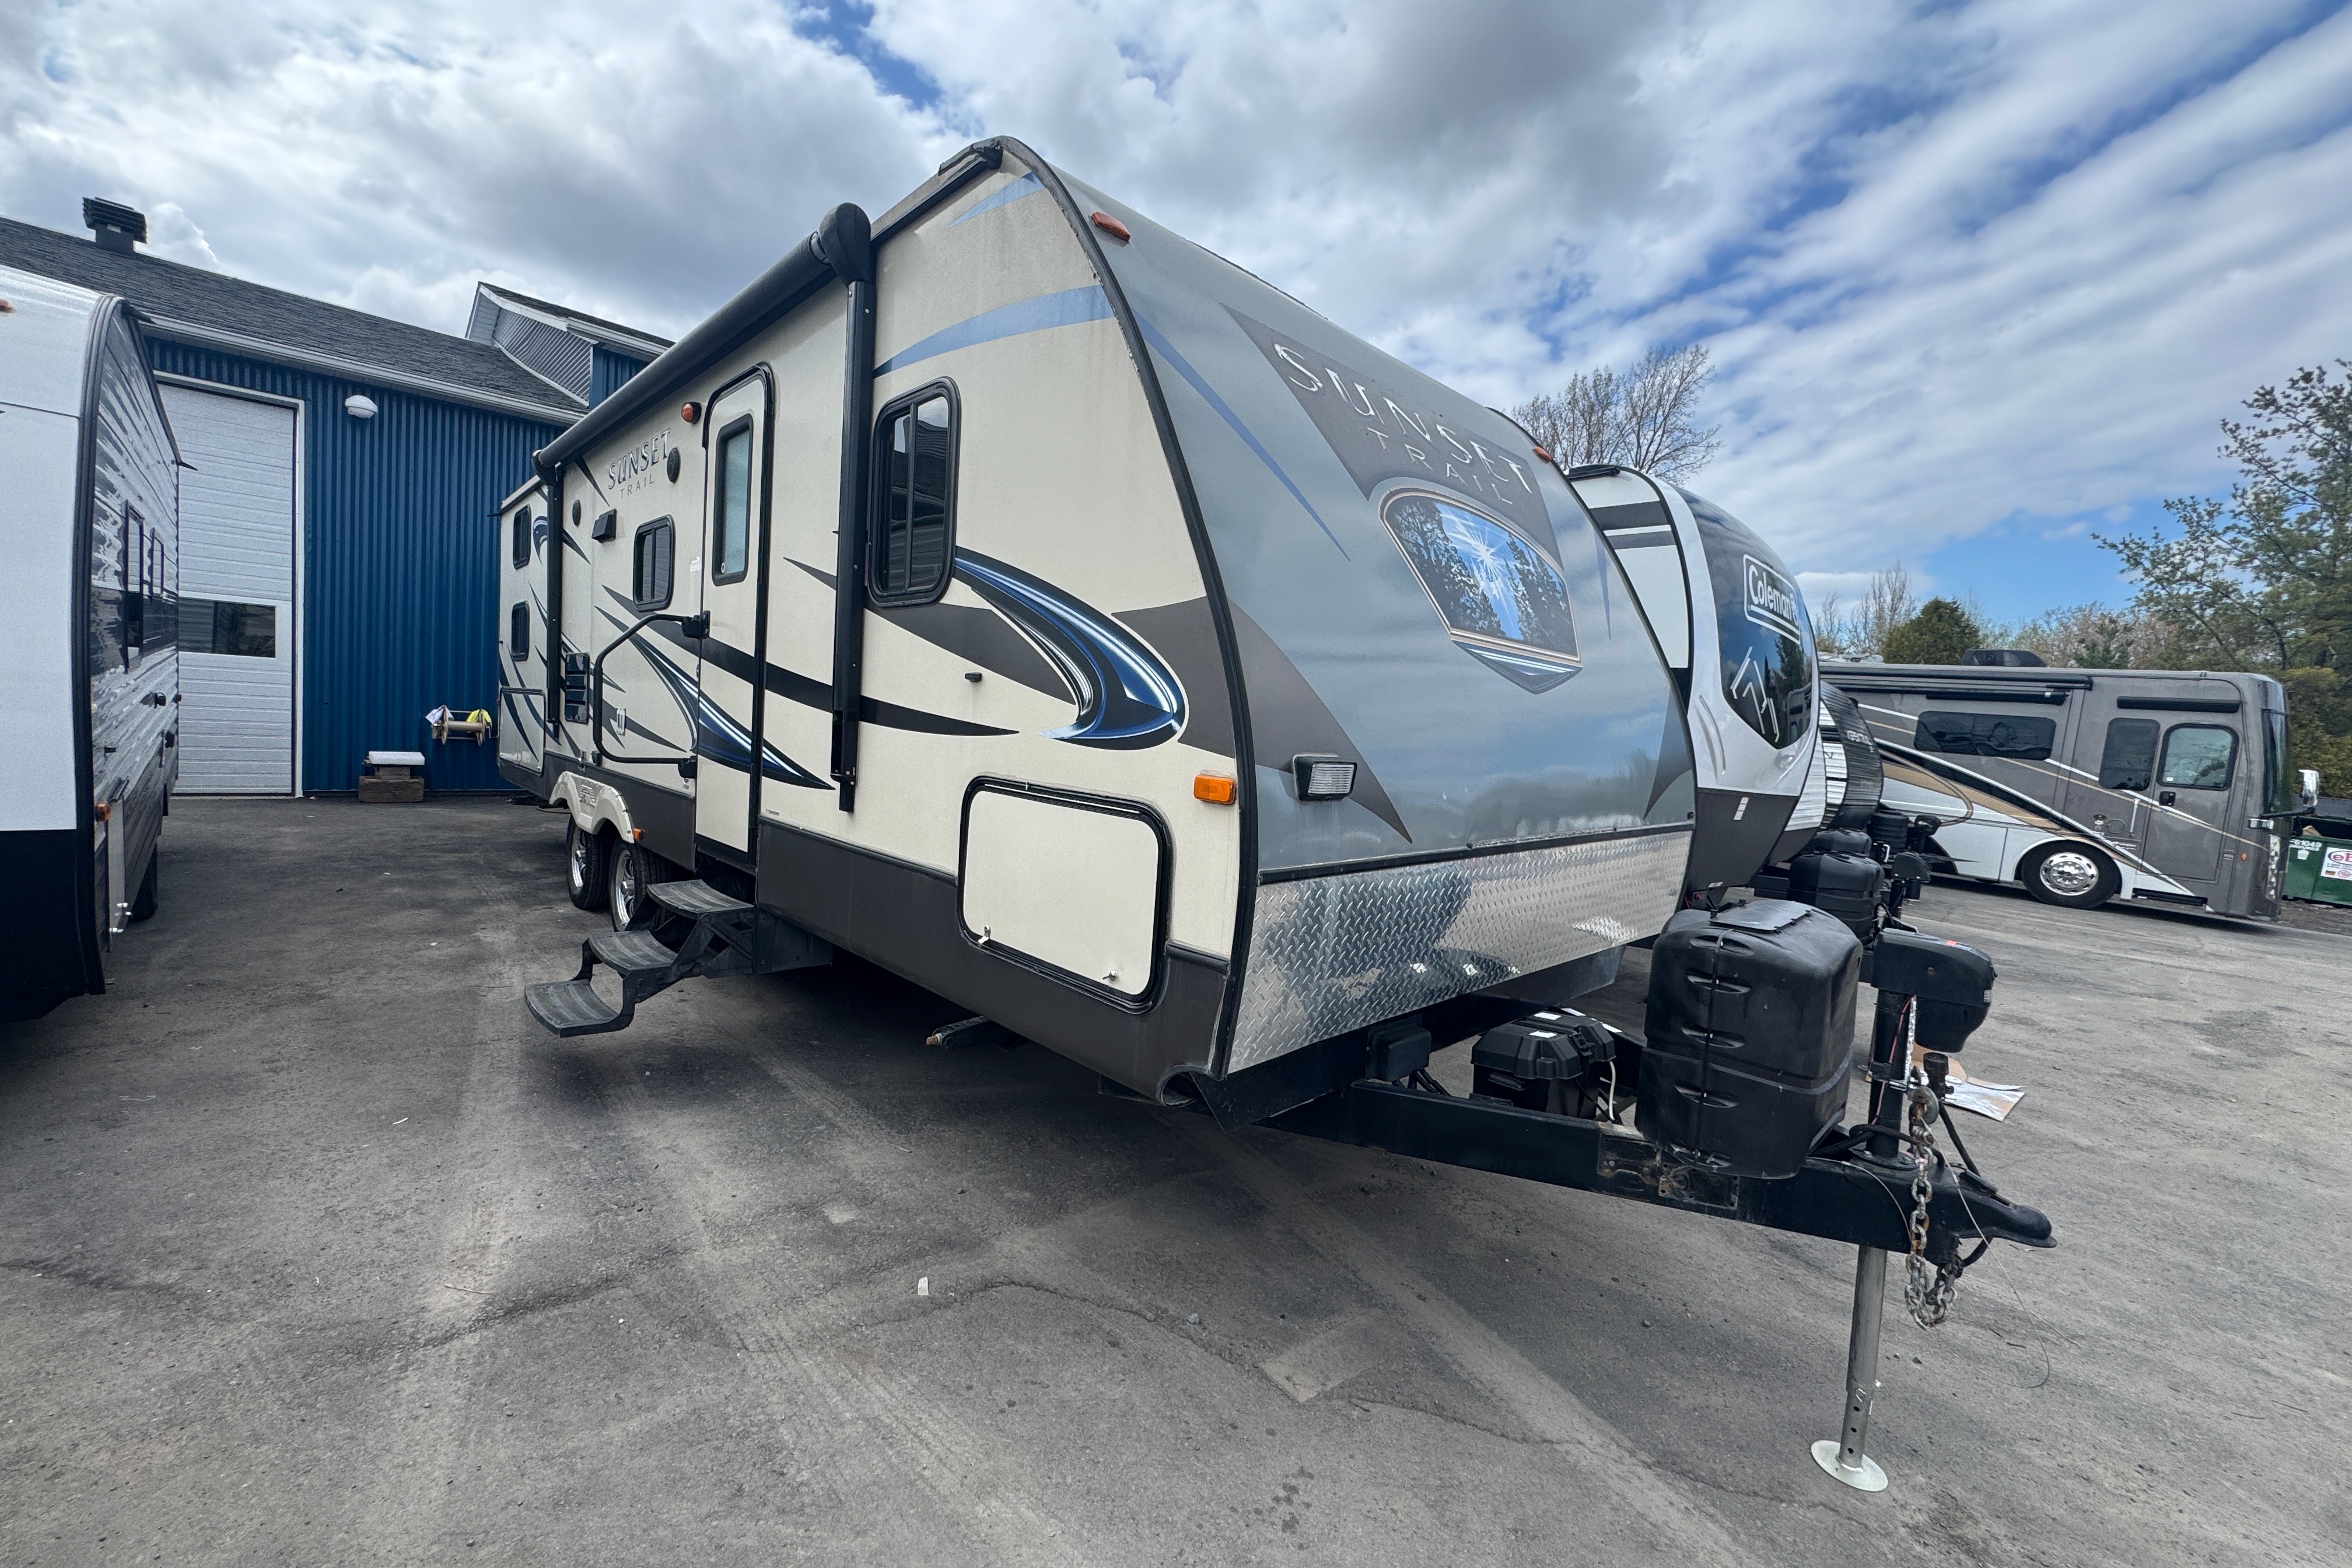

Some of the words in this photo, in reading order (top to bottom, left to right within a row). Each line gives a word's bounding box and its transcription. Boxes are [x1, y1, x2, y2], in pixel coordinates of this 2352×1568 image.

[1274, 342, 1533, 495] SUNSET
[608, 426, 671, 490] SUNSET
[620, 473, 655, 499] TRAIL
[1366, 426, 1513, 505] TRAIL
[1748, 564, 1793, 621] Coleman
